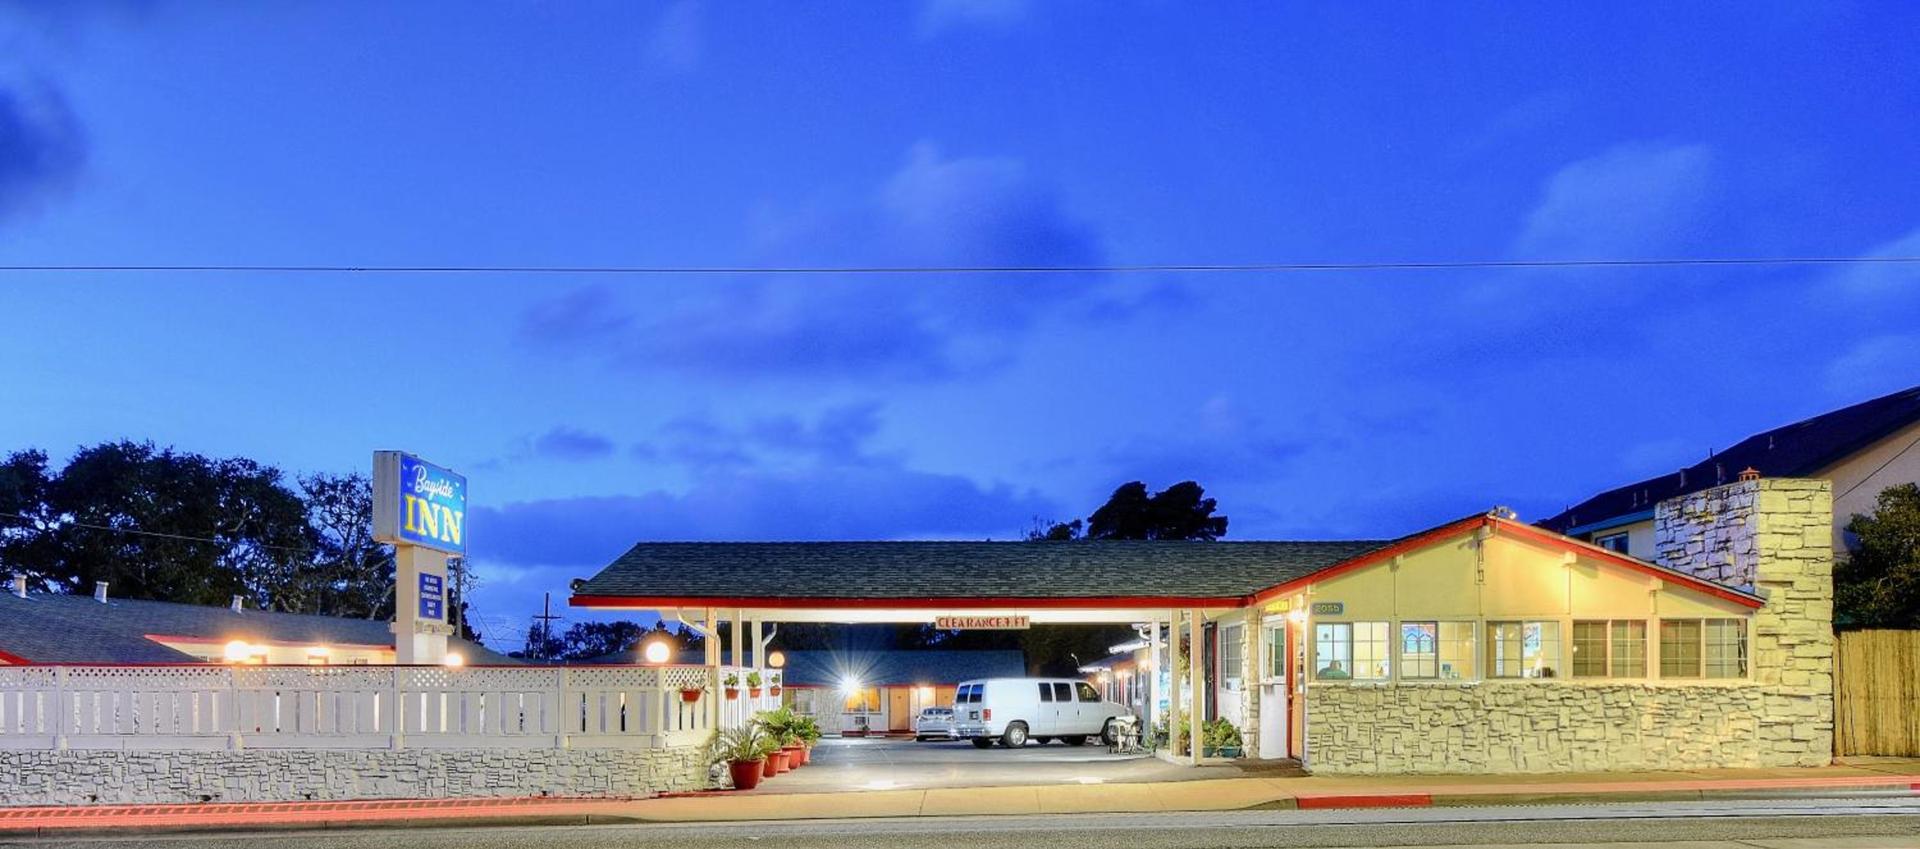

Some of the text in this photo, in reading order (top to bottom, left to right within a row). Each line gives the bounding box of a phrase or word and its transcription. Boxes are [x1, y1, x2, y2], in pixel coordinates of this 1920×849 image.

[412, 464, 454, 500] Bayside
[404, 494, 464, 545] INN
[938, 617, 1002, 628] CLEARANCE
